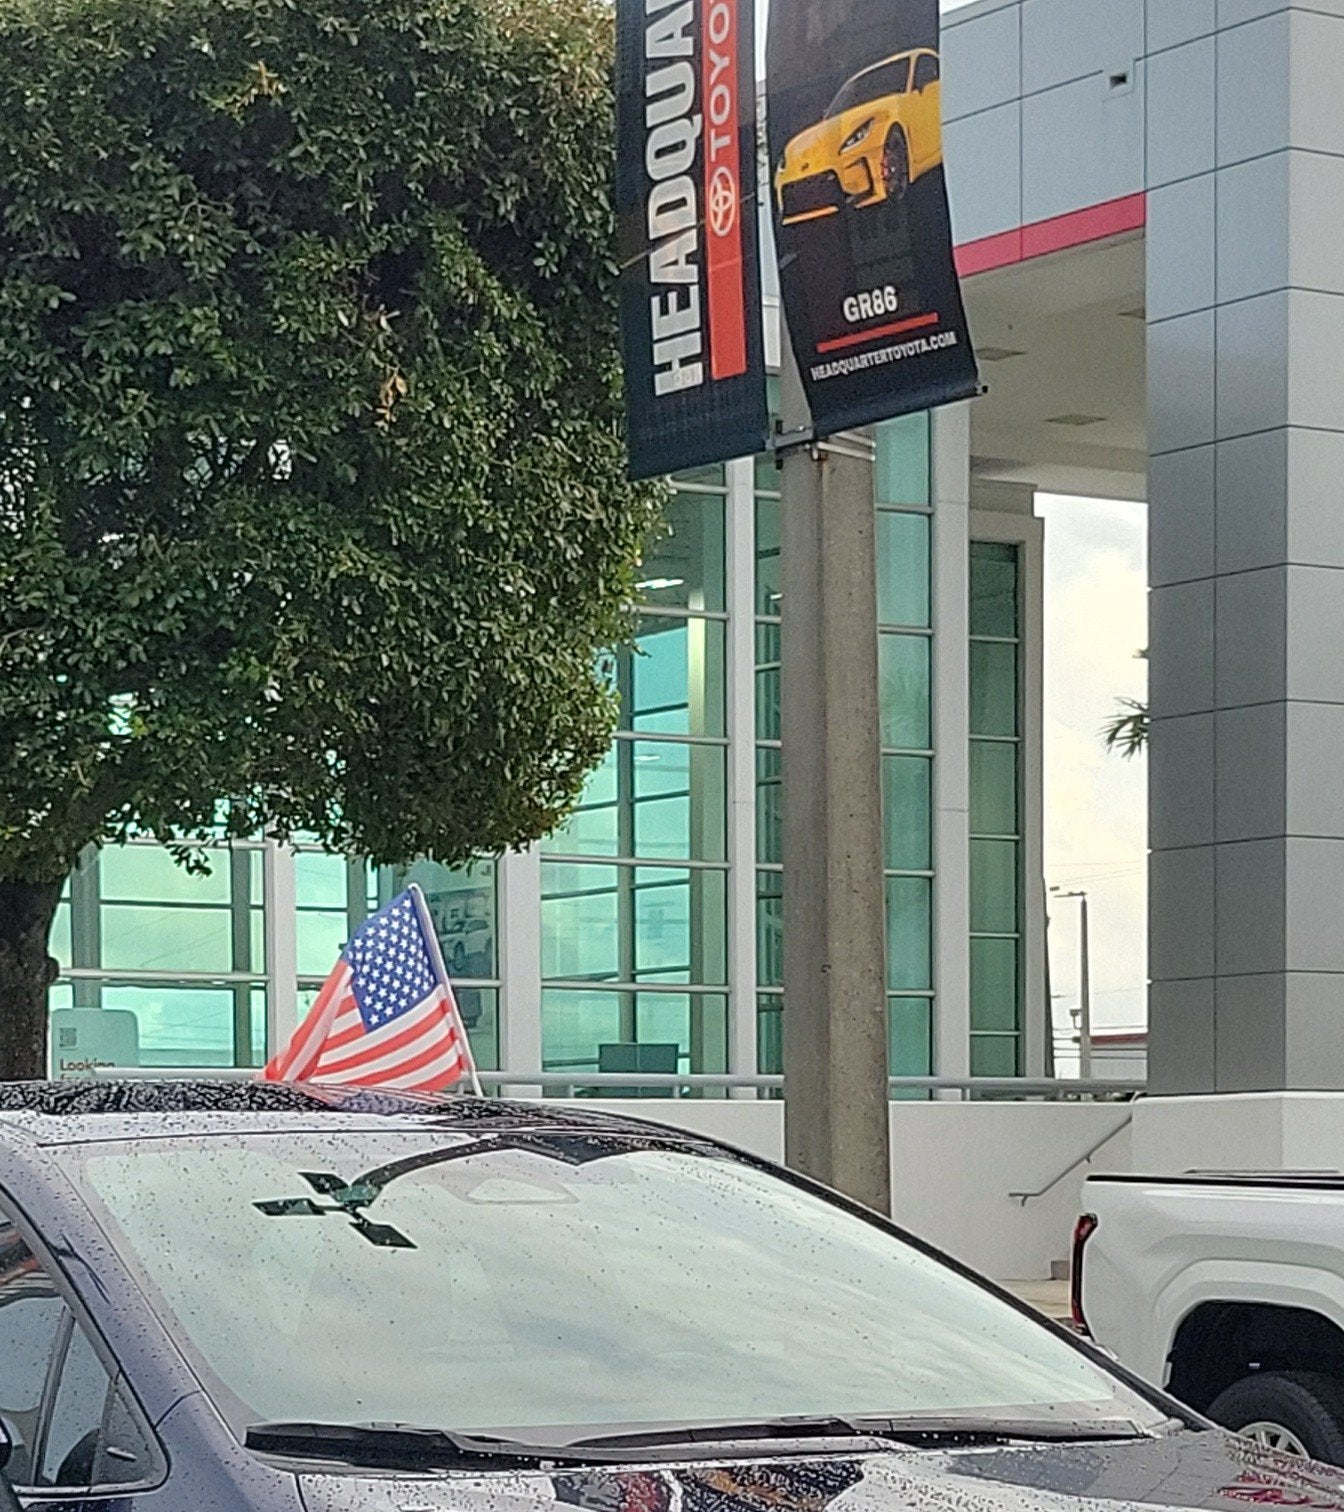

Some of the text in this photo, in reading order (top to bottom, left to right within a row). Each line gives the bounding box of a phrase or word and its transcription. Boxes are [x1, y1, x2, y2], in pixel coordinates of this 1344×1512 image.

[708, 0, 732, 162] TOYO
[644, 0, 703, 396] HEADQUA
[809, 331, 957, 381] HEADQUARTERTOYOTA.COM
[843, 285, 898, 323] GR86
